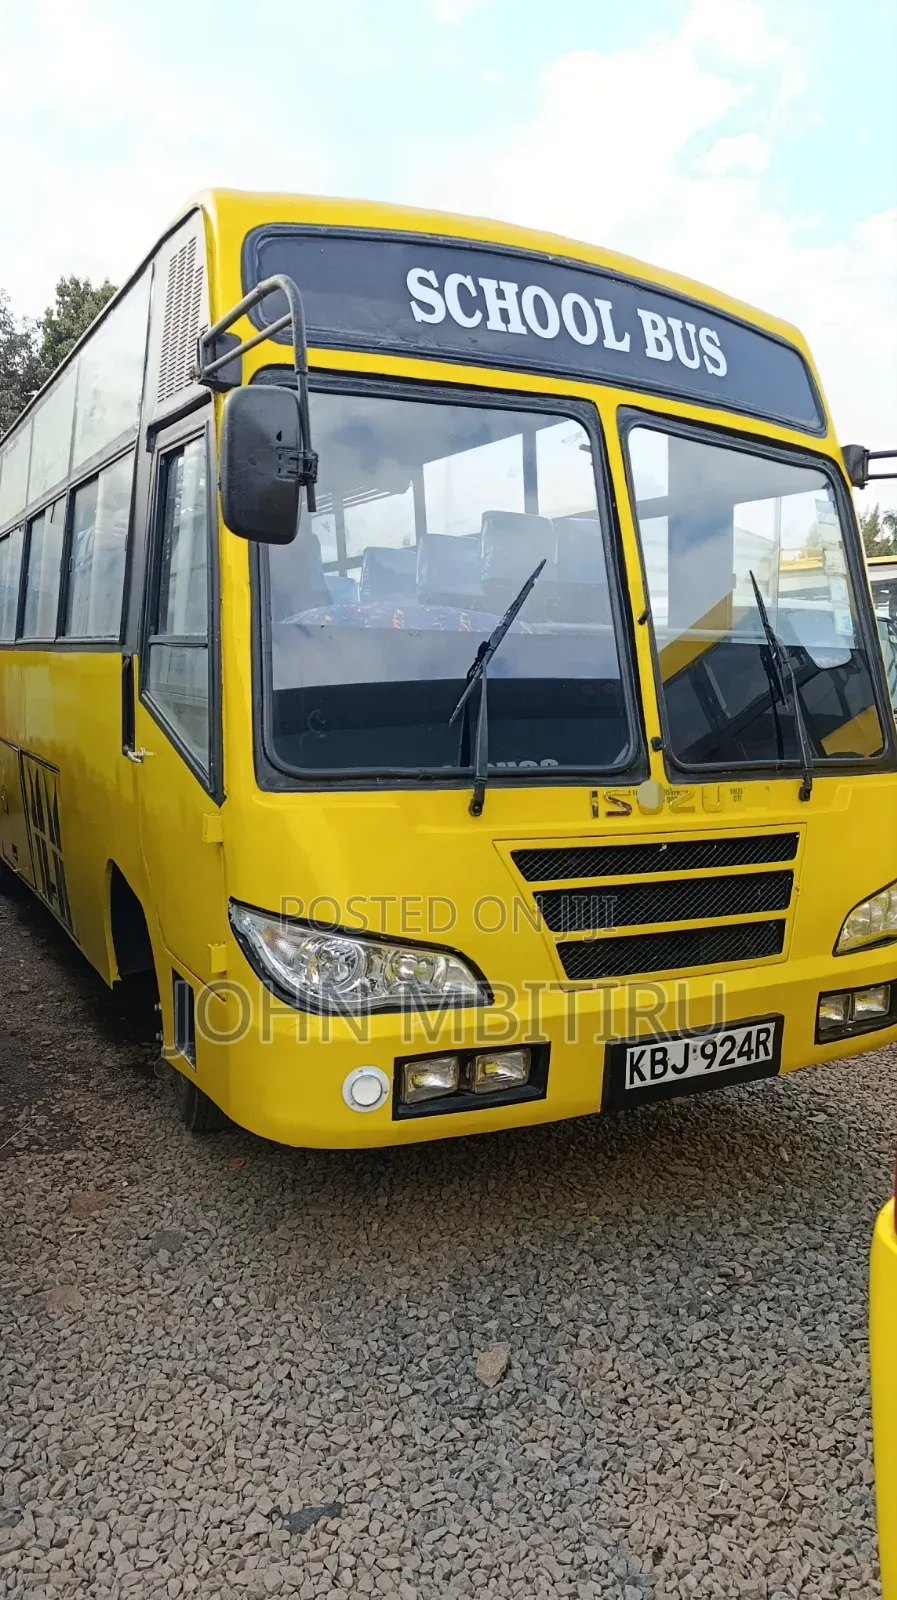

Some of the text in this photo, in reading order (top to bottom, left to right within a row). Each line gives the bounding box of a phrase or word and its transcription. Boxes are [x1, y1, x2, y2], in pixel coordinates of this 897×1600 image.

[406, 267, 728, 378] SCHOOL BUS
[589, 784, 726, 819] ISZU
[629, 1027, 771, 1085] KBJ 924R
